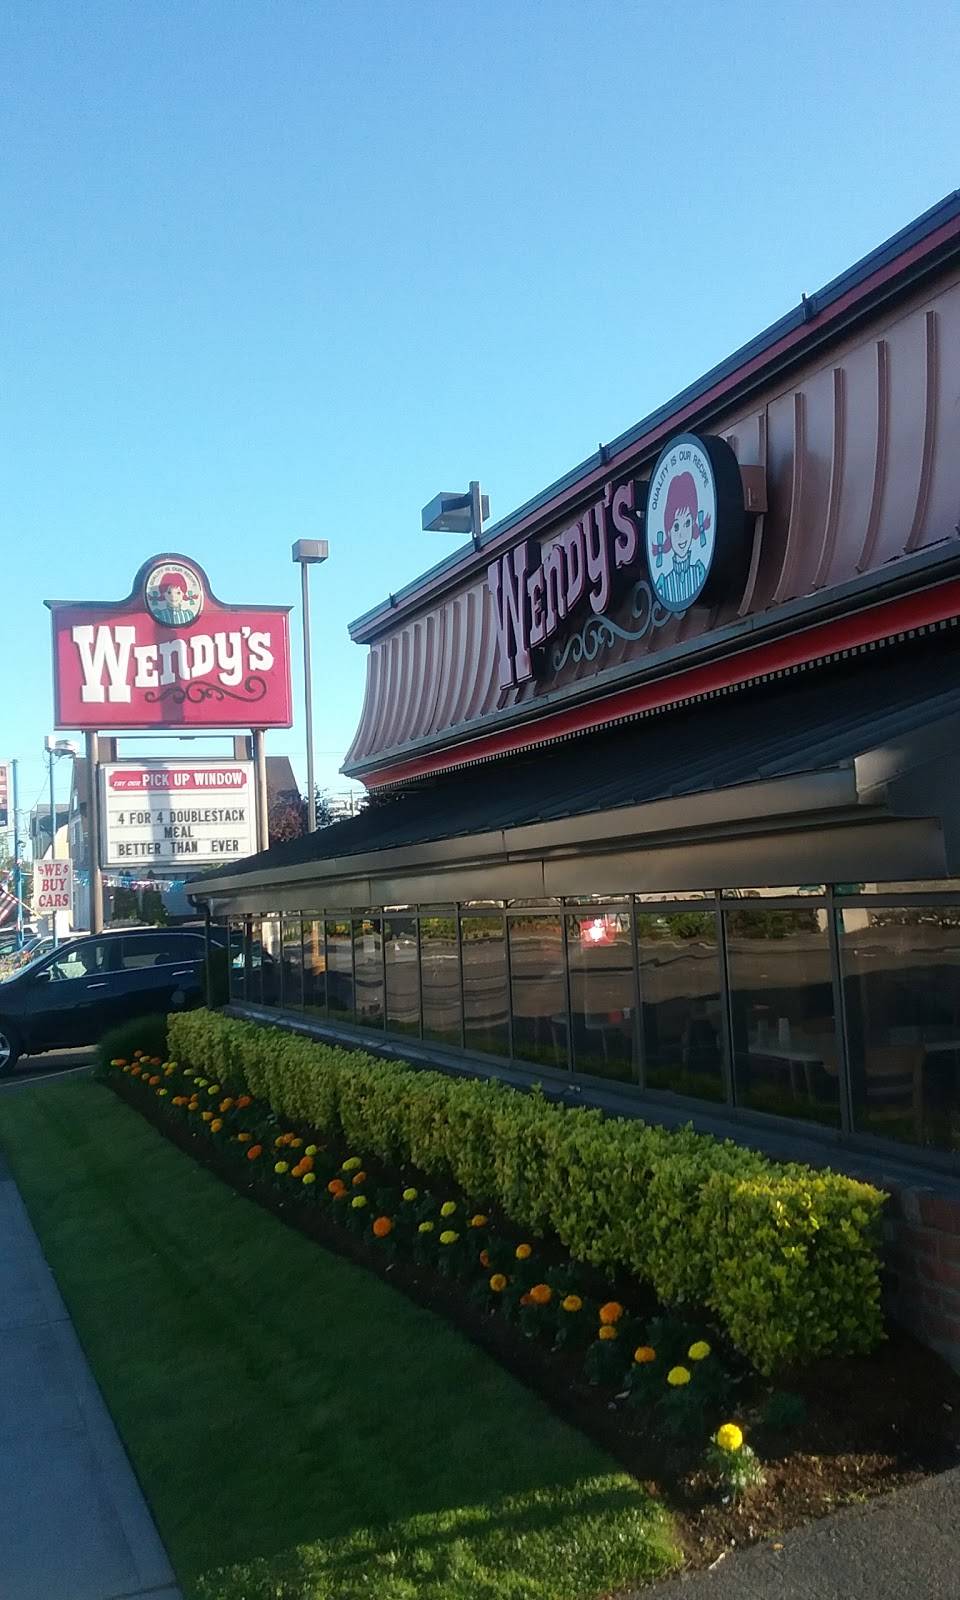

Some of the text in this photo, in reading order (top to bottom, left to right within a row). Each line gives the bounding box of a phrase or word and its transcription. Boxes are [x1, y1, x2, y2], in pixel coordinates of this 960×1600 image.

[651, 451, 710, 511] QUALITY IS OUR RECIPE
[142, 773, 169, 787] PICK
[174, 773, 190, 786] UP
[194, 772, 243, 786] WINDOW
[118, 809, 245, 824] 4 FOR 4 DOUBLESTACK
[164, 826, 194, 838] MEAL
[118, 840, 239, 856] BETTER THAN EVER
[42, 878, 67, 892] BUY
[38, 893, 69, 907] CARS
